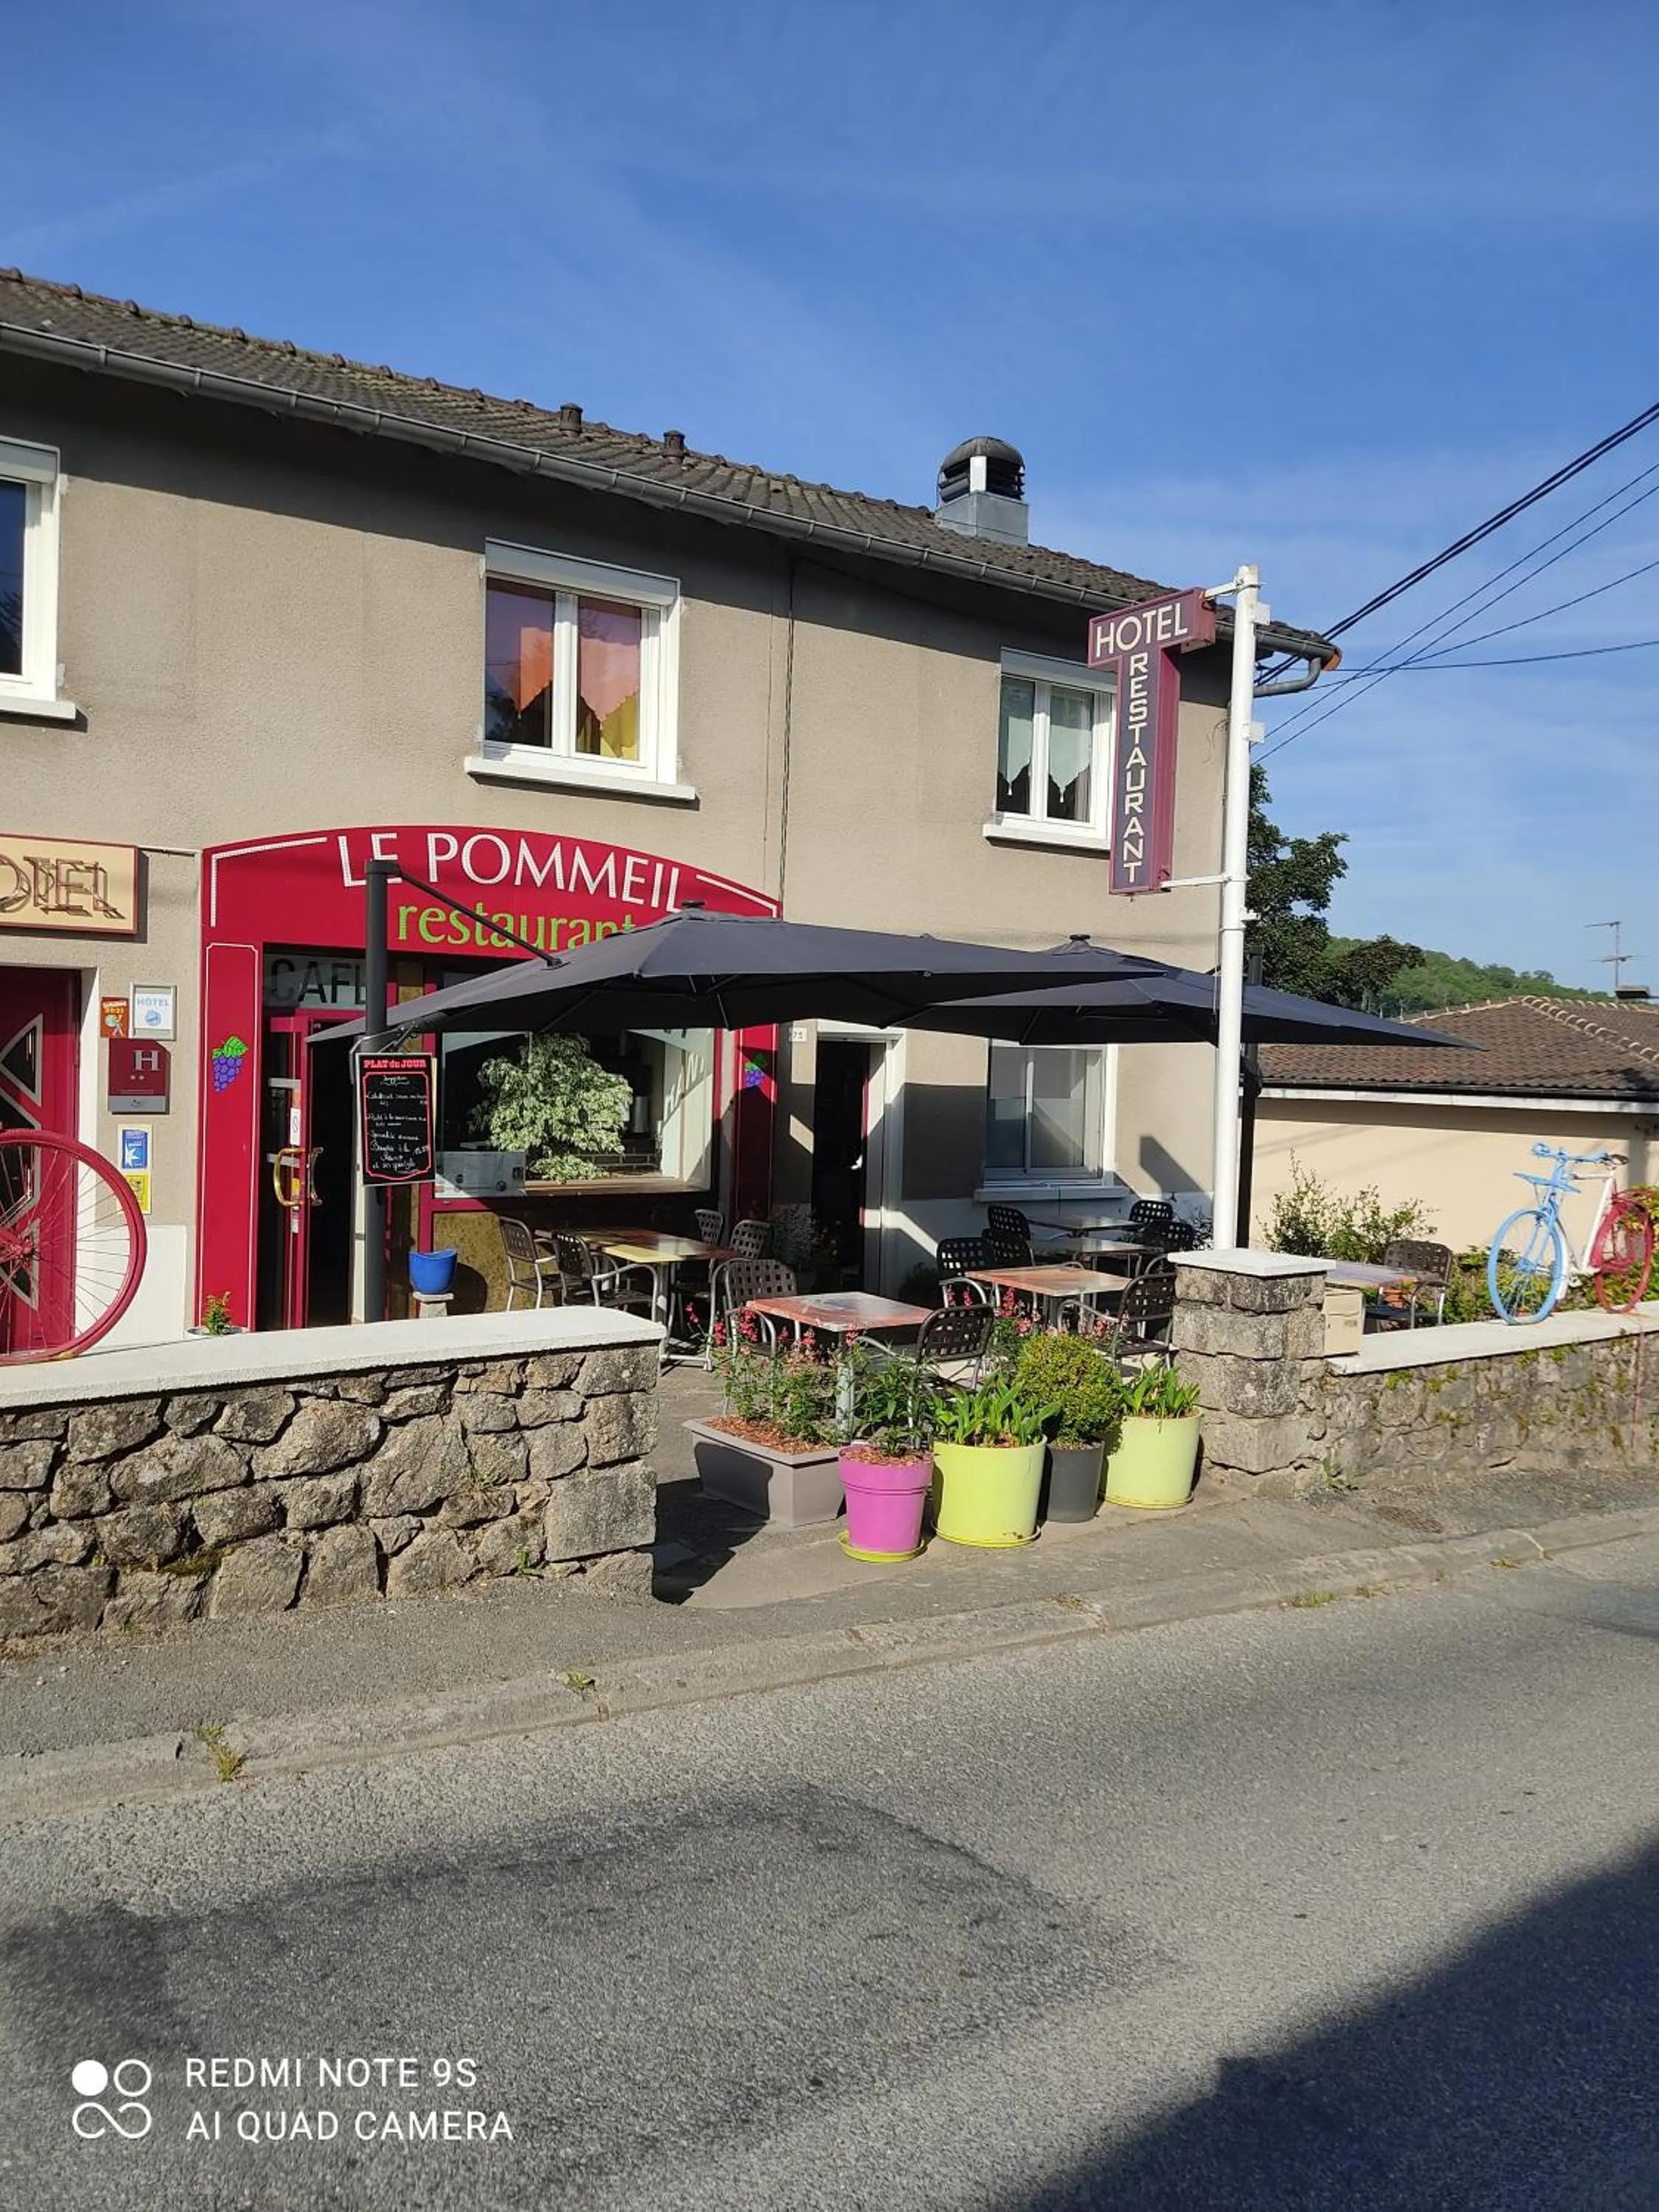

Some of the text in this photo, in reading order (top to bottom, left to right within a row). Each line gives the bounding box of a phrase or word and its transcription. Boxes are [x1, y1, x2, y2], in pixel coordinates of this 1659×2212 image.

[1095, 602, 1189, 658] HOTEL
[1123, 653, 1148, 884] RESTAURANT
[338, 832, 683, 914] LE POMMEIL
[133, 1050, 160, 1071] H
[364, 1060, 388, 1068] PLAT
[401, 1060, 427, 1068] JOUR
